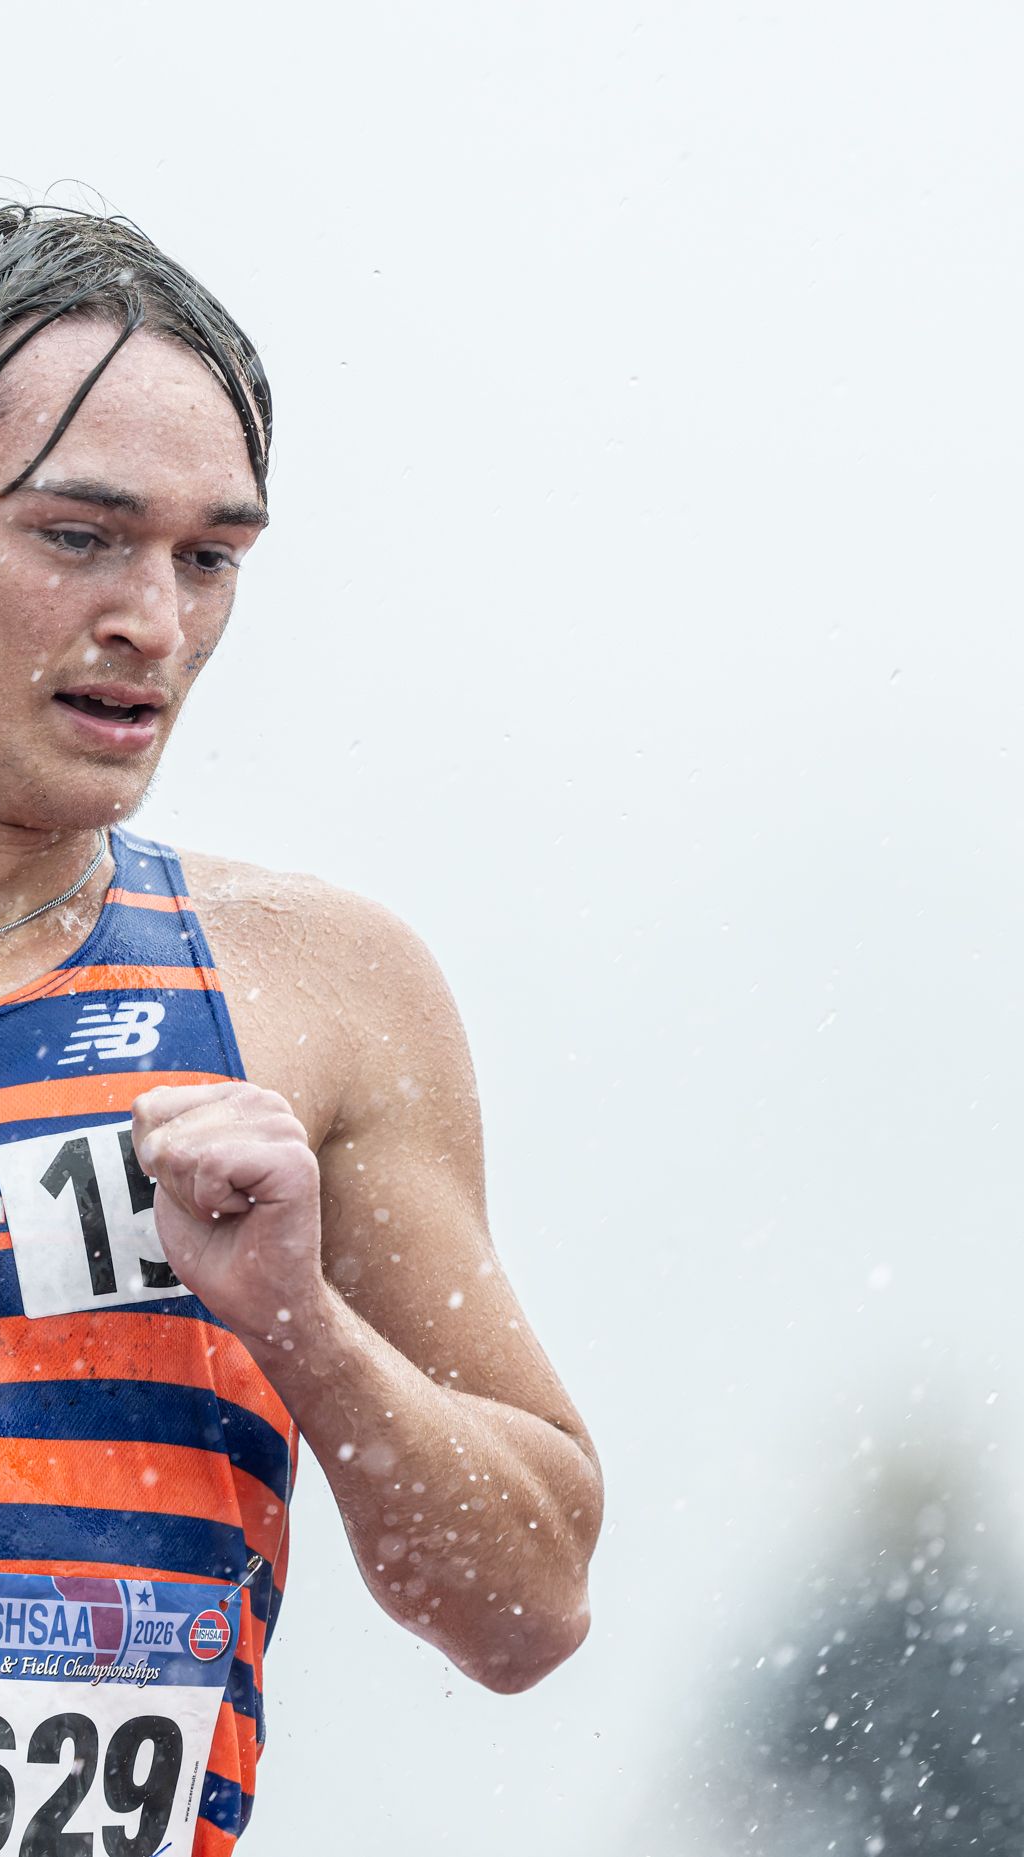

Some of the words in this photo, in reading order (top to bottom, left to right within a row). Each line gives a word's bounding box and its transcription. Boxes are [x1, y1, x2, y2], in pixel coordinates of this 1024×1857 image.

[57, 1001, 164, 1065] NB
[133, 1620, 174, 1645] 2026
[196, 1628, 223, 1640] MSHSAA
[0, 1655, 21, 1674] &
[21, 1654, 62, 1677] Field
[64, 1656, 161, 1688] Championships
[184, 1760, 200, 1823] www.raceresult.com
